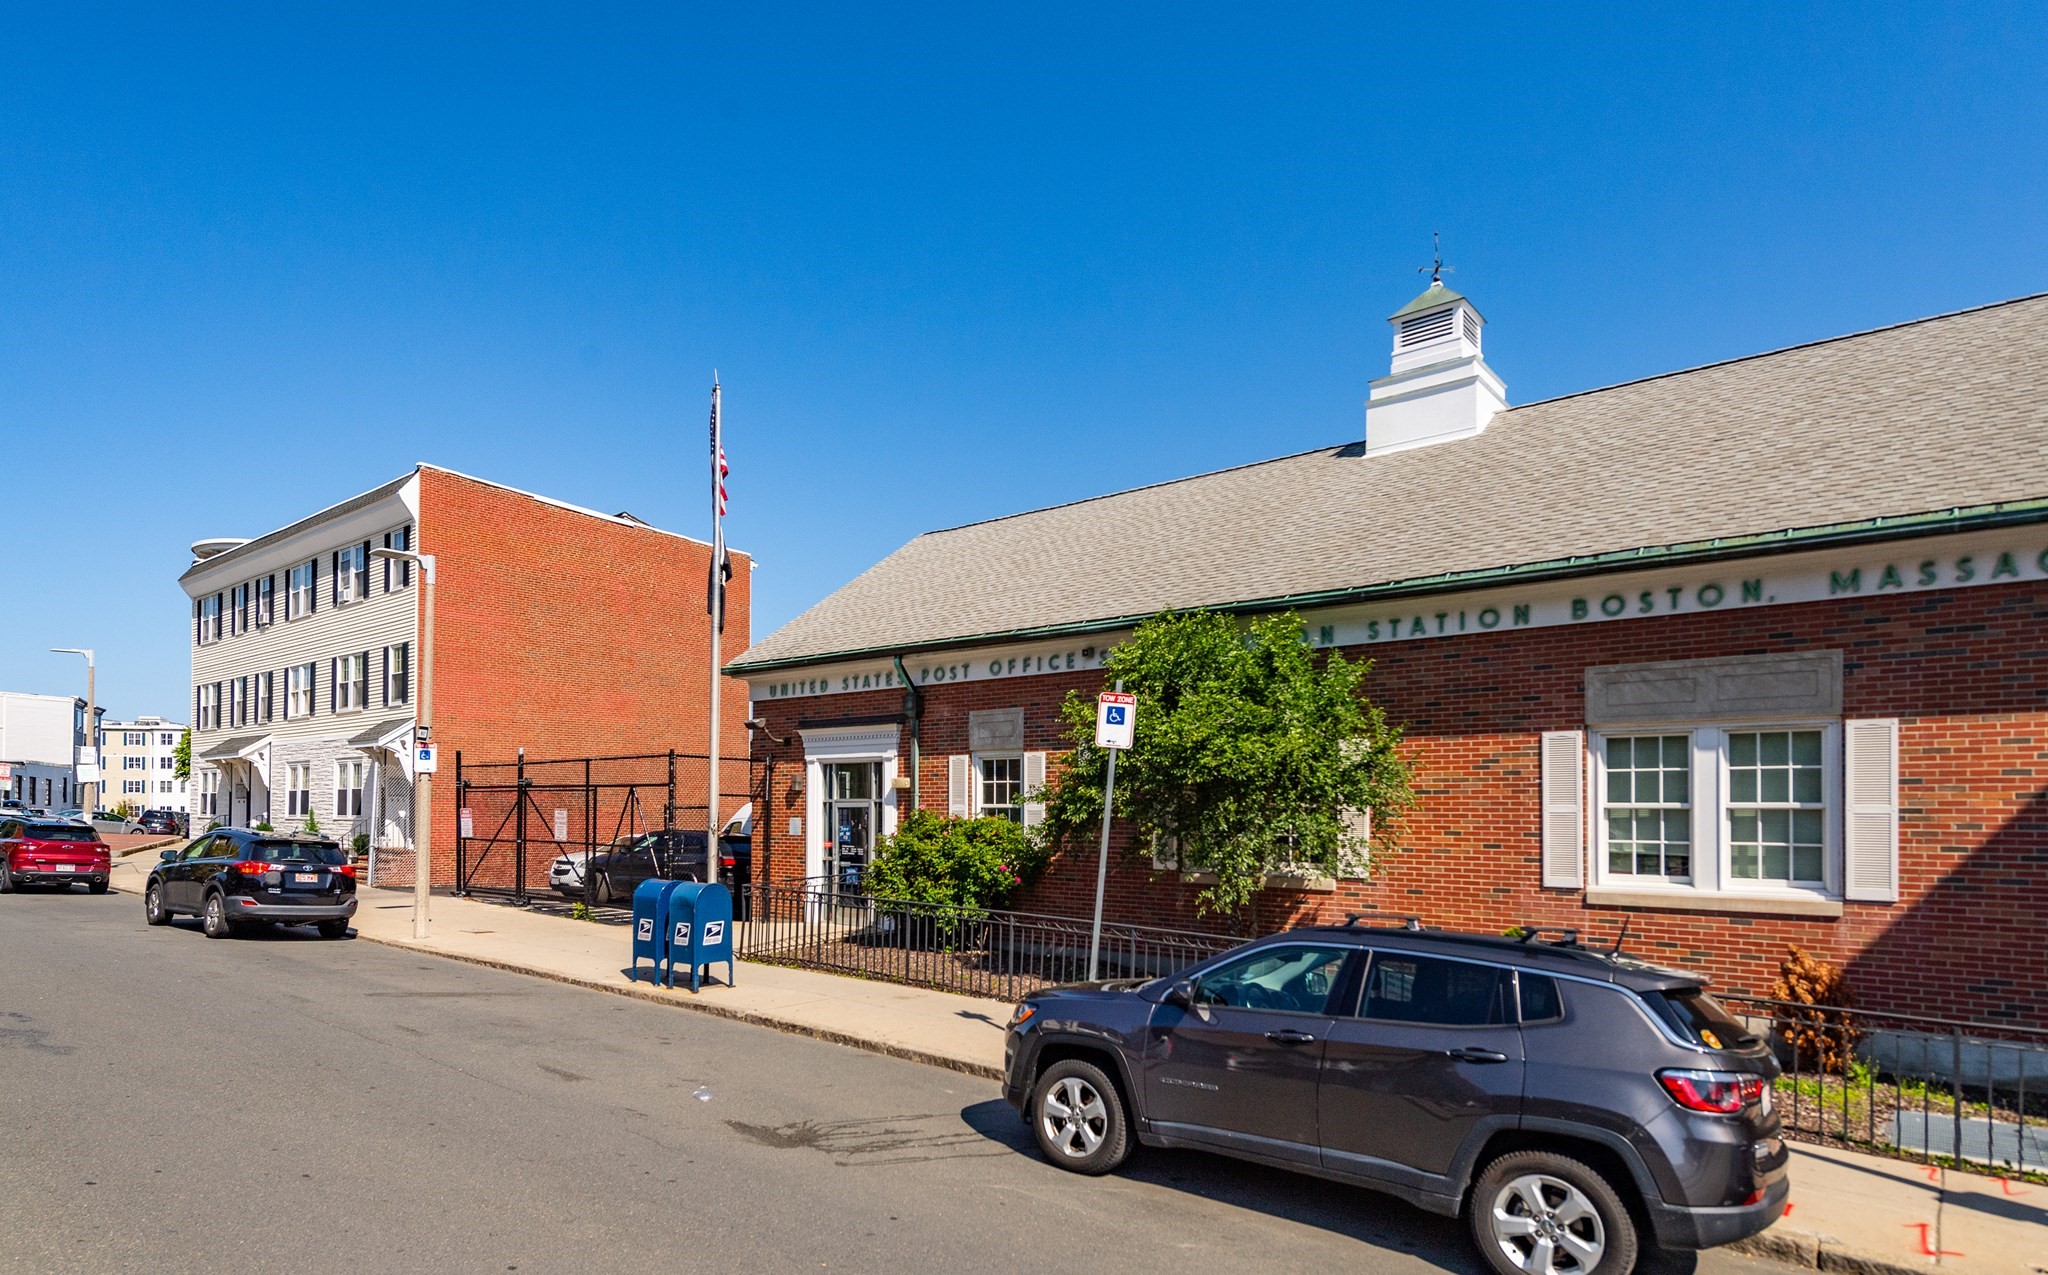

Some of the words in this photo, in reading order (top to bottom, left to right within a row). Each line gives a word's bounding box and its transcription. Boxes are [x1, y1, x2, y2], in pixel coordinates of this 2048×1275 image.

[1367, 604, 1530, 640] STATION
[1571, 578, 1776, 621] BOSTON,
[769, 679, 829, 698] UNITED
[921, 663, 970, 681] POST
[989, 651, 1076, 677] OFFICE
[1102, 695, 1116, 703] TOW
[1117, 696, 1134, 704] ZONE
